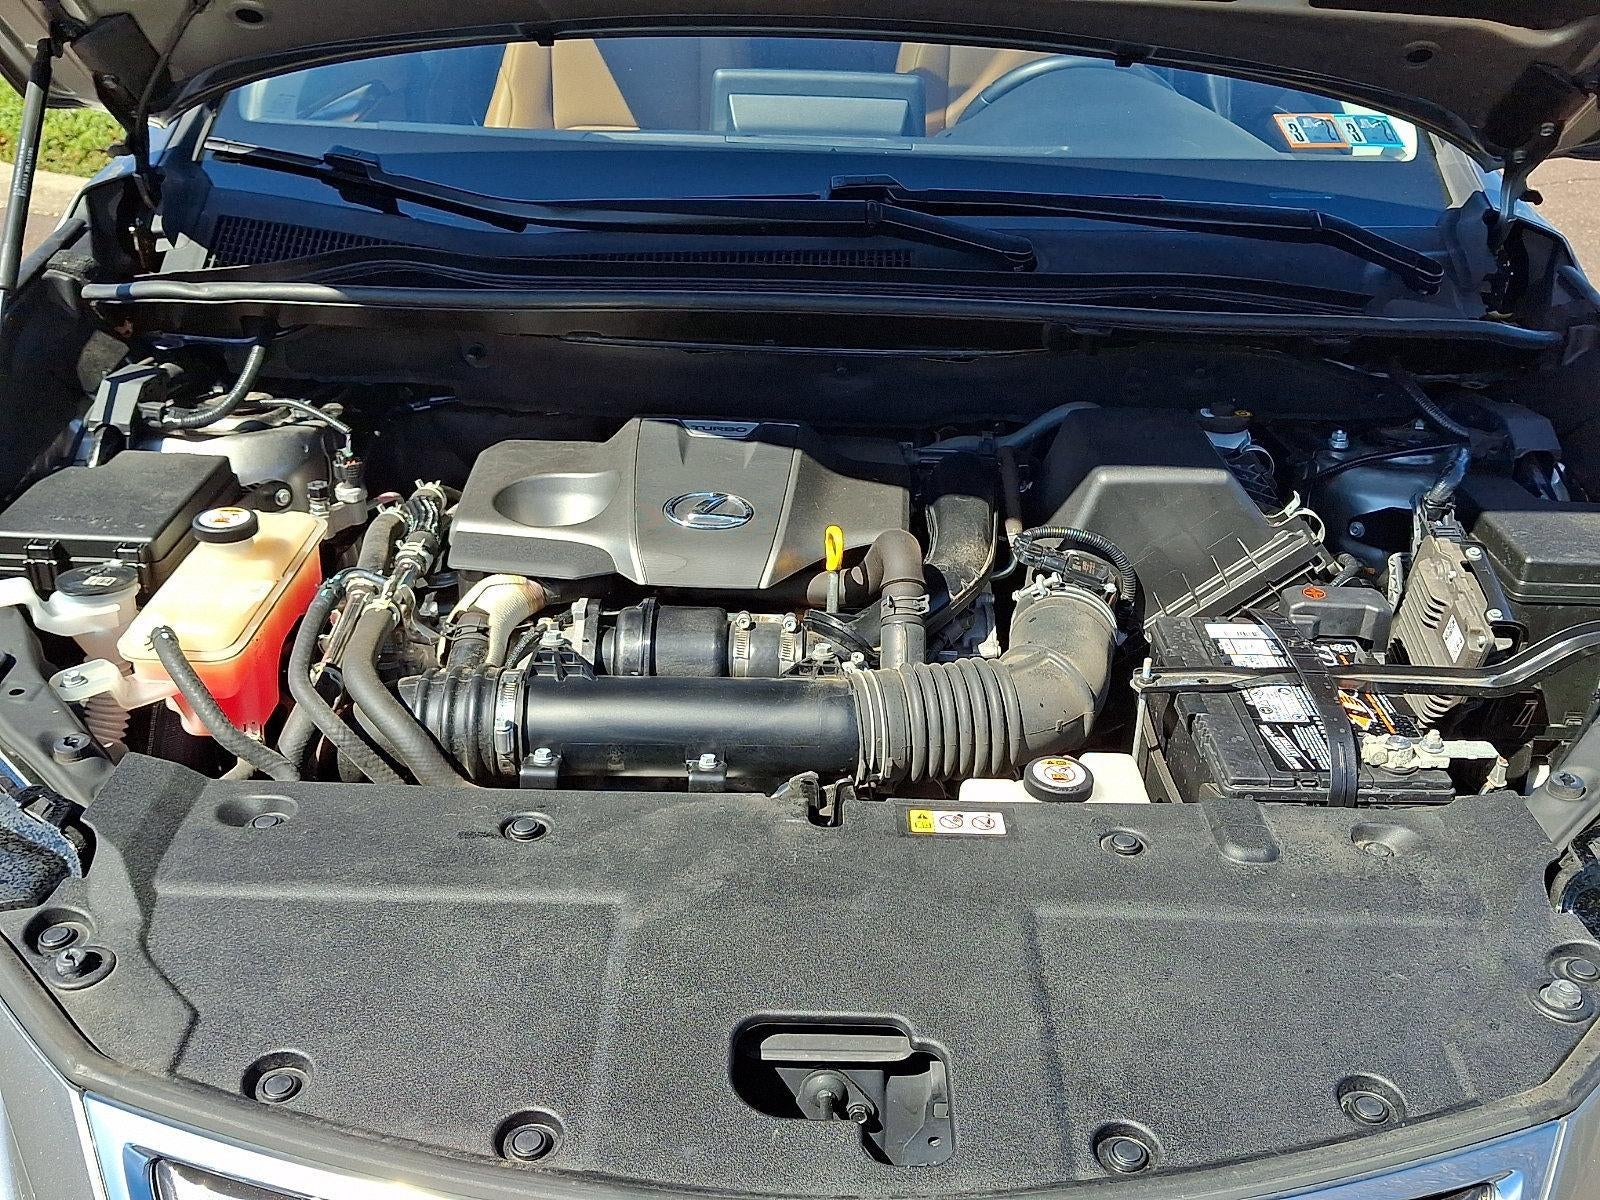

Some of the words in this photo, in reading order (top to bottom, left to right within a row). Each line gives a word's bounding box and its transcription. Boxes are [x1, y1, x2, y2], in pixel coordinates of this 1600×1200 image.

[1288, 123, 1305, 142] 3
[1345, 123, 1362, 142] 3
[692, 424, 748, 433] TURBO
